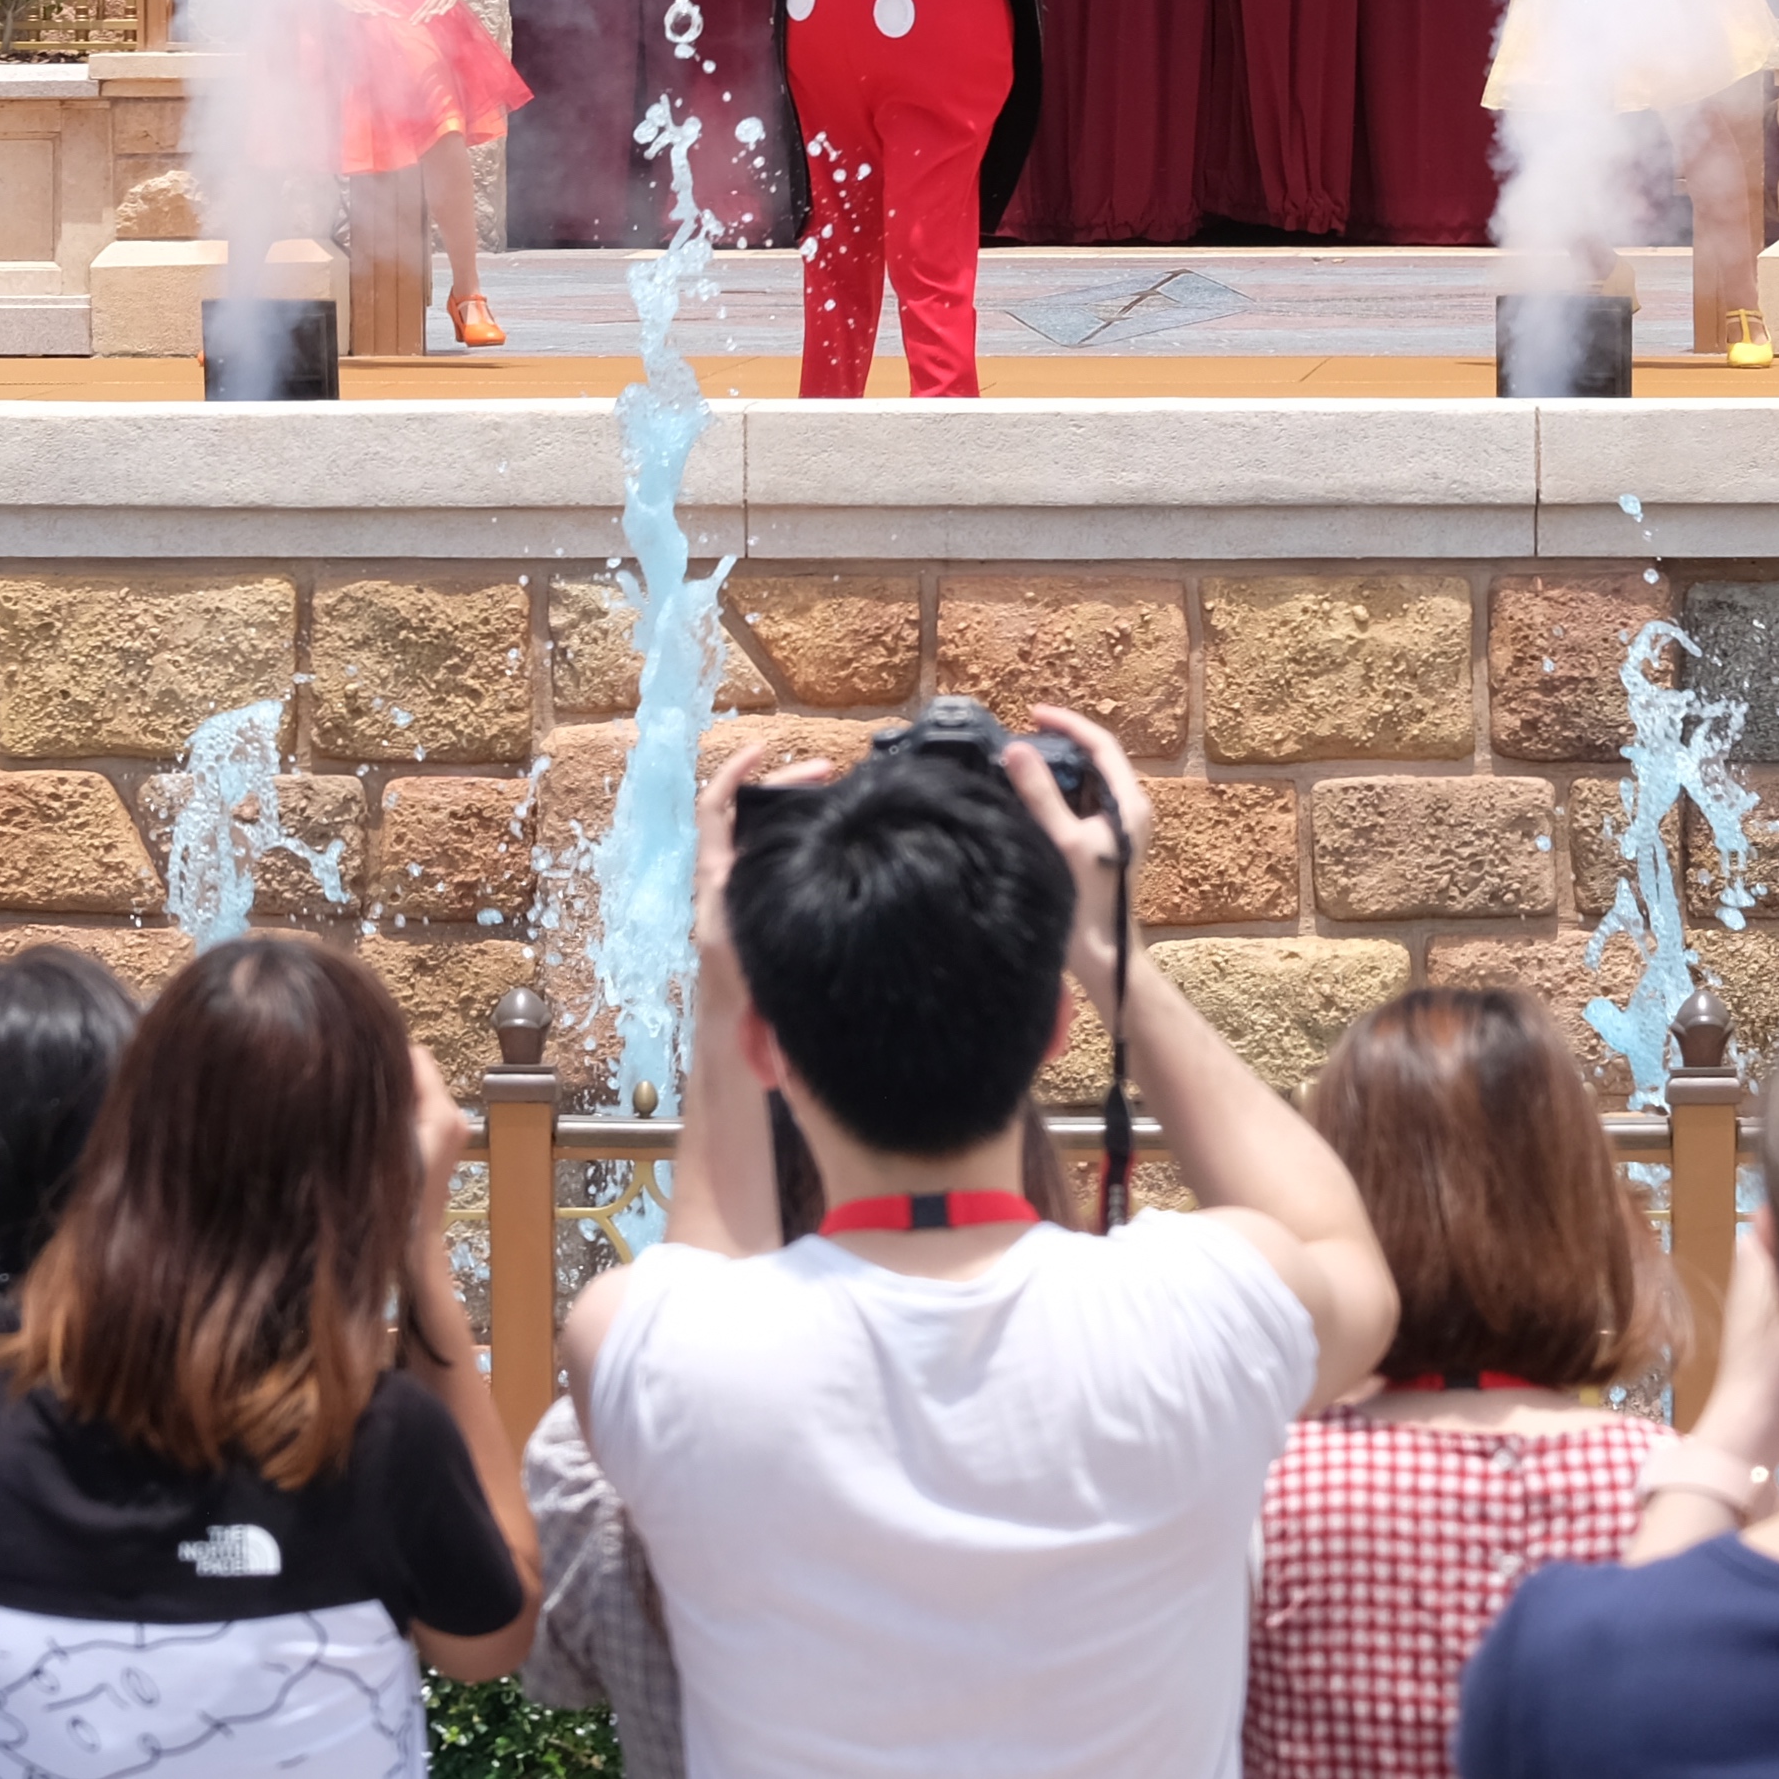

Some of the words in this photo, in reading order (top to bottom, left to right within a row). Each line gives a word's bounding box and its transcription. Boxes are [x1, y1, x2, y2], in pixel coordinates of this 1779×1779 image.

[206, 1524, 242, 1542] THE
[178, 1540, 242, 1562] NORTH
[195, 1559, 242, 1577] FACE
